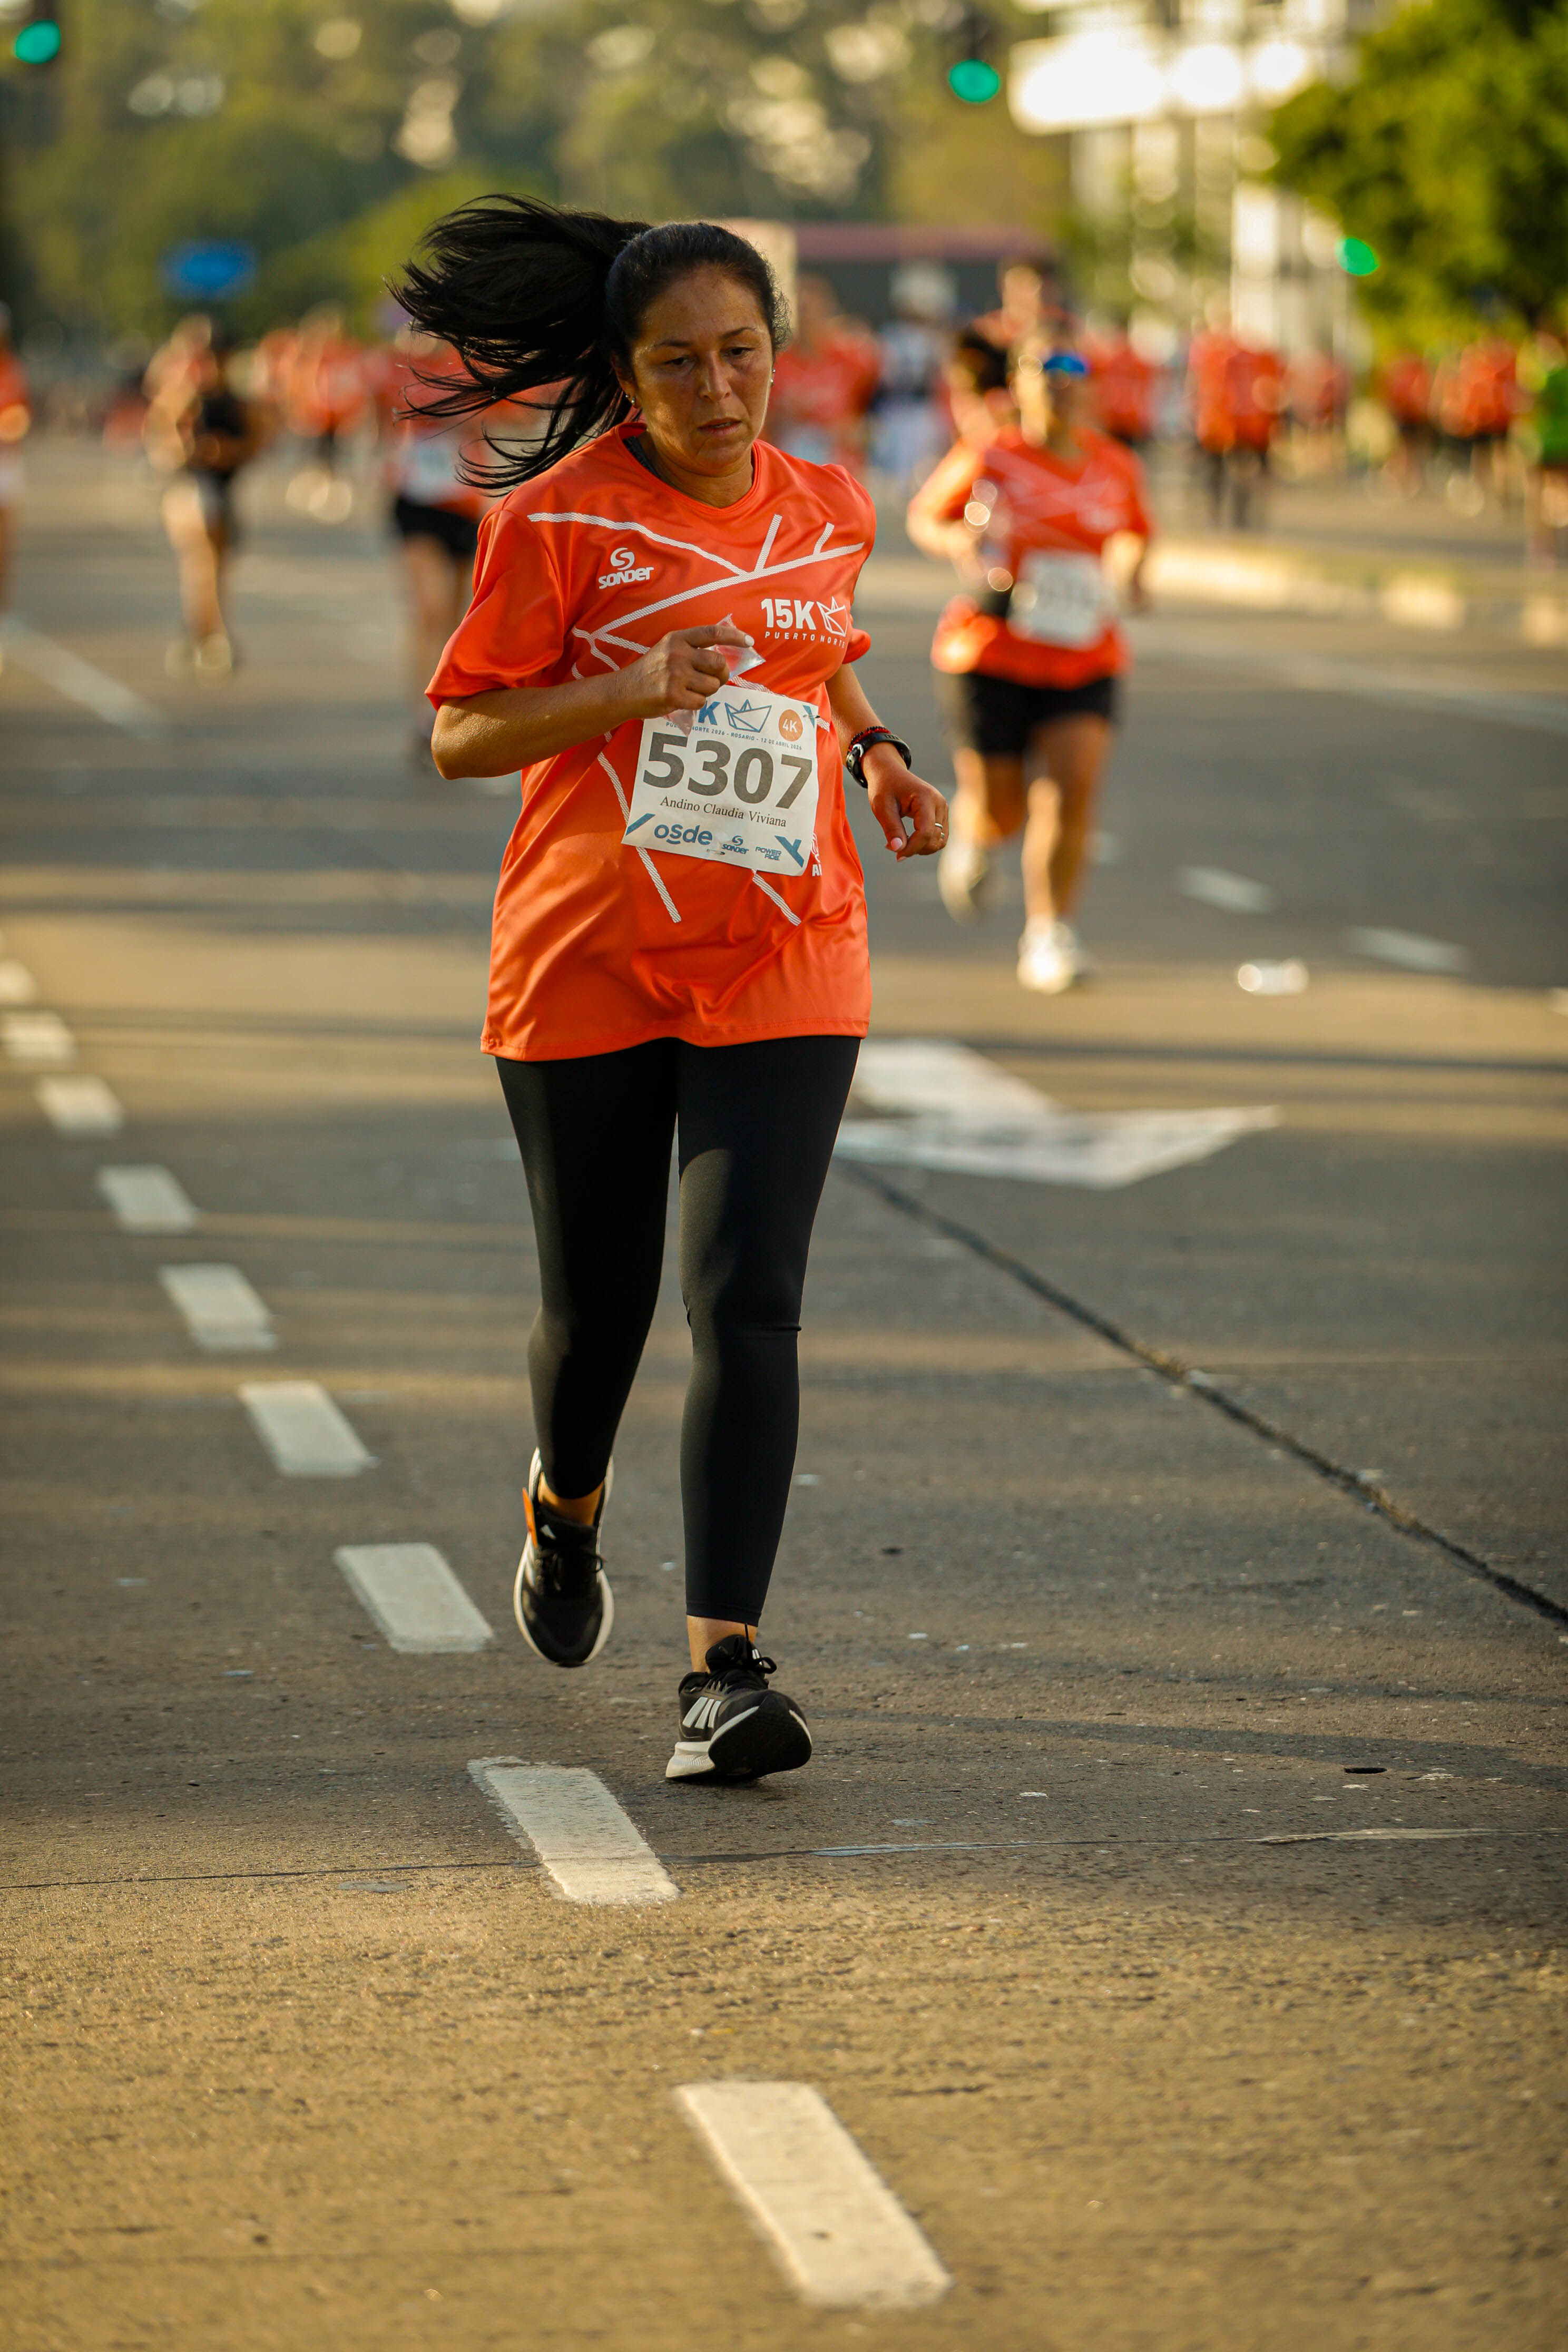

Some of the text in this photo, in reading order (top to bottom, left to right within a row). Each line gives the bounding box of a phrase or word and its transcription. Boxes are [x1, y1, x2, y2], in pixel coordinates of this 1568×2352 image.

[761, 599, 817, 630] 15K
[765, 631, 845, 648] PUERTO NORTE
[730, 732, 755, 741] ROSARIO
[782, 719, 798, 733] 4K
[643, 731, 812, 809] 5307
[660, 796, 787, 827] Andino Claudia Viviana
[654, 824, 713, 846] osde
